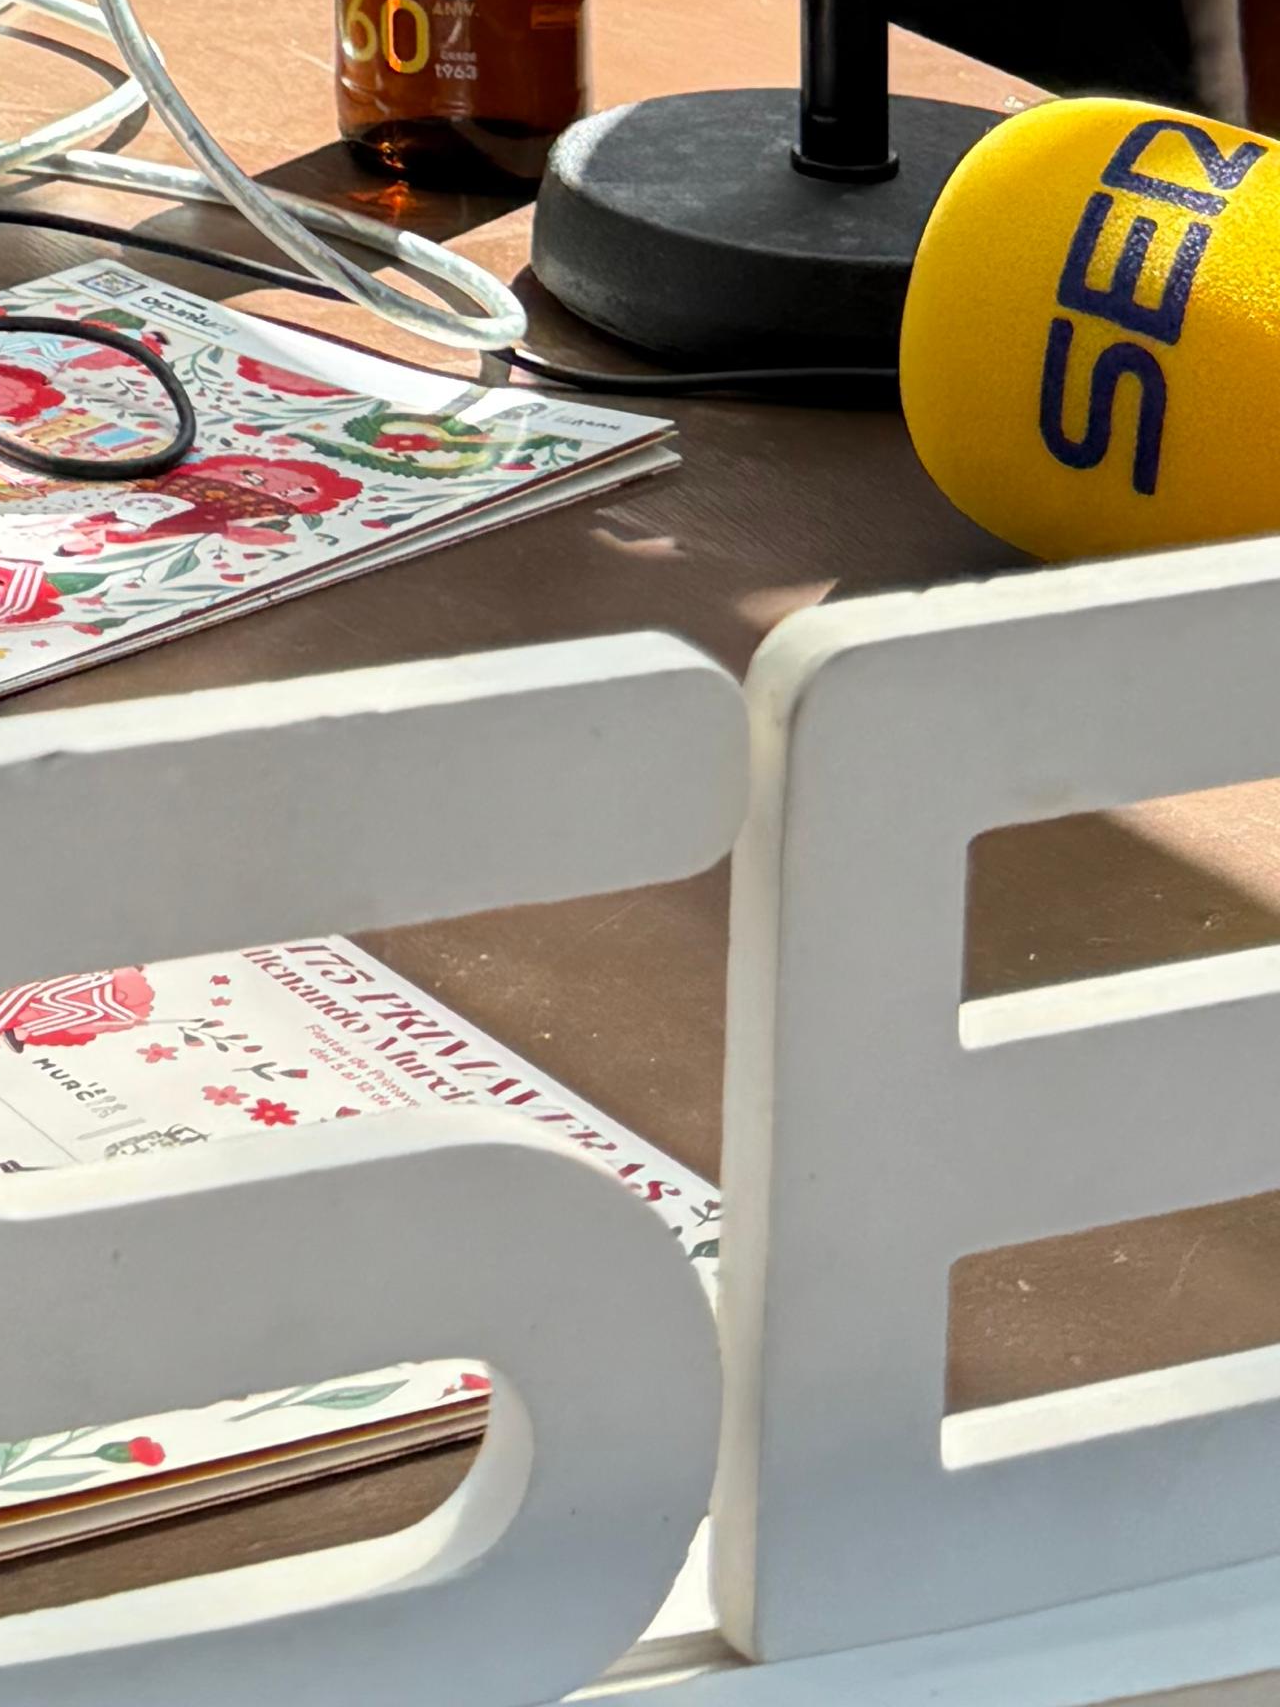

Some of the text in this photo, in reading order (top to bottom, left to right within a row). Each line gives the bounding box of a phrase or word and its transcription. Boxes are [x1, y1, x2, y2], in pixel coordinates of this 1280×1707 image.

[434, 64, 479, 81] 1963
[1038, 117, 1270, 497] SER
[286, 942, 377, 987] 175
[364, 1036, 480, 1106] Murci
